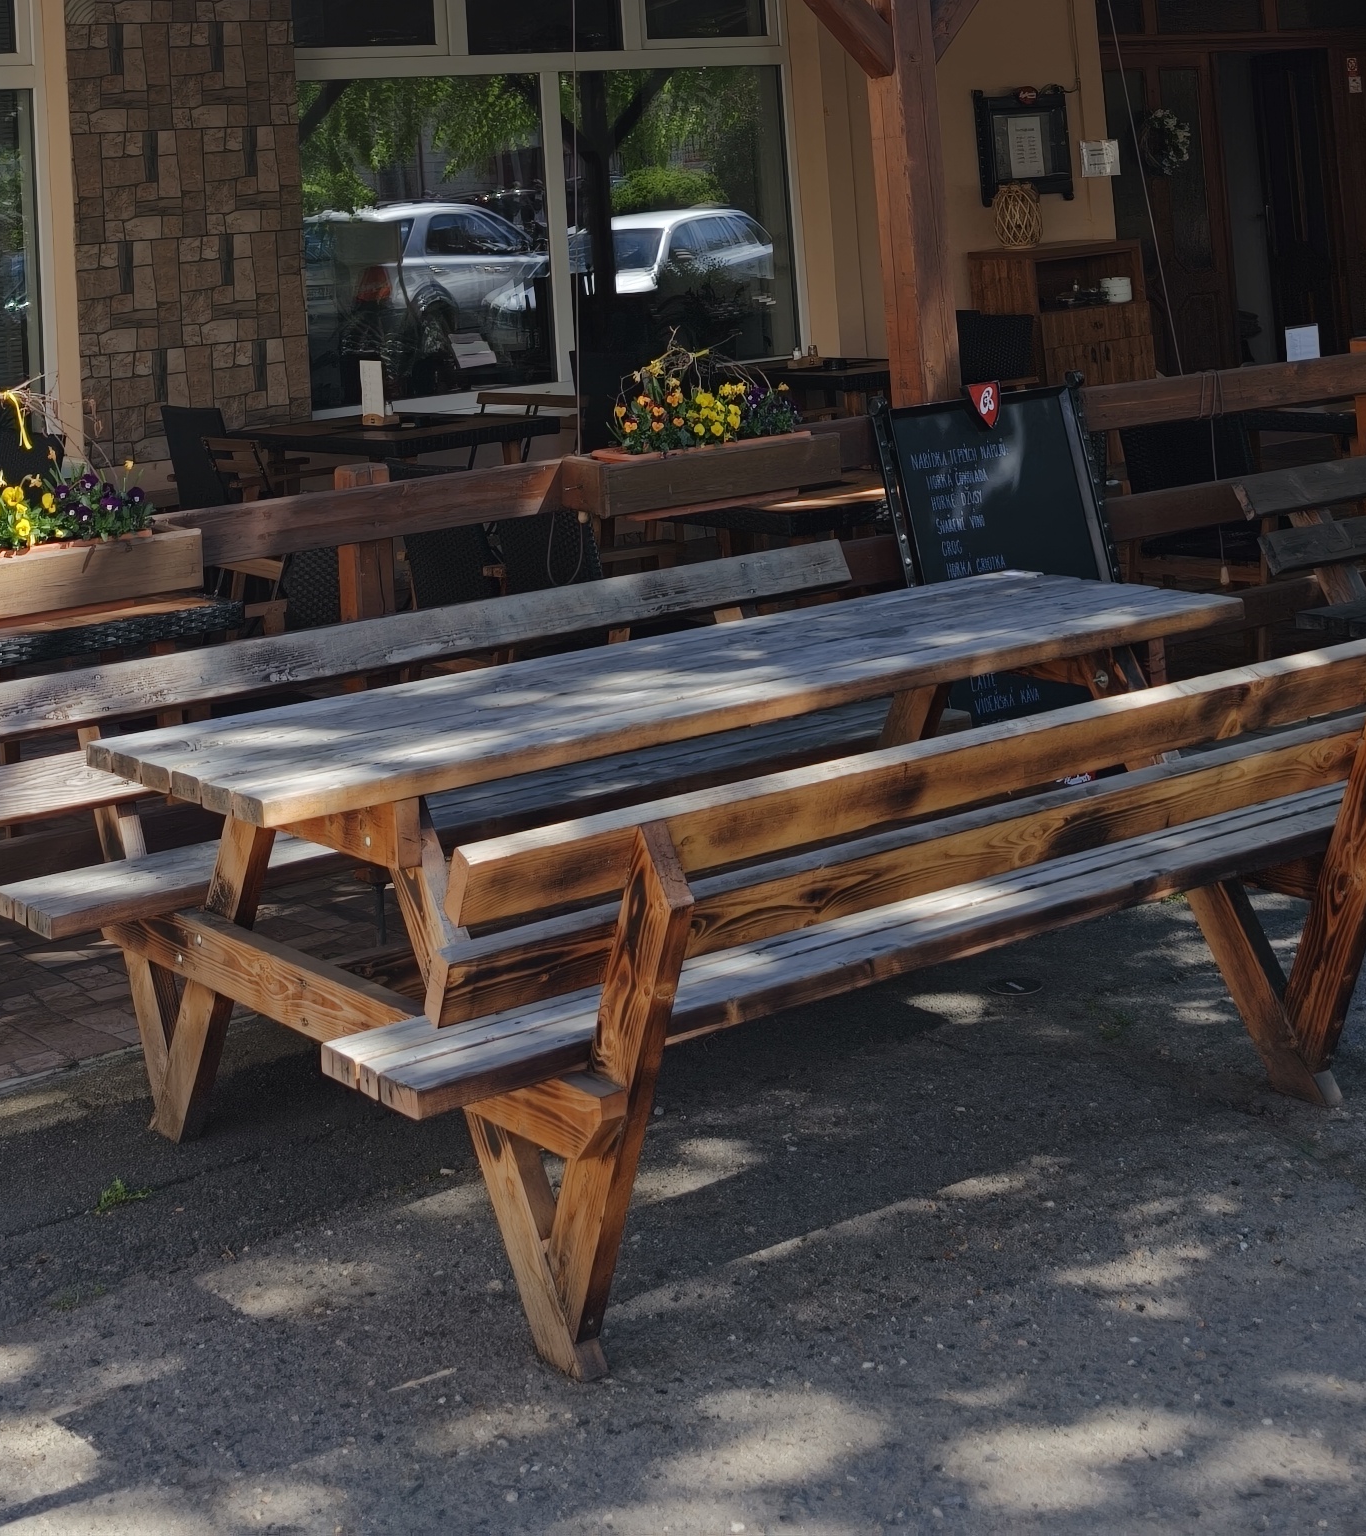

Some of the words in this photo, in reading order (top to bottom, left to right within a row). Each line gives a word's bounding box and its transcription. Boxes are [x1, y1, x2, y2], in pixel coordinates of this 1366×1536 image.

[910, 448, 948, 470] NABÍDKA
[925, 468, 954, 490] HORKÁ
[930, 488, 957, 511] HORKÉ
[960, 486, 983, 506] DŽUSY
[1019, 682, 1040, 704] KÁVA
